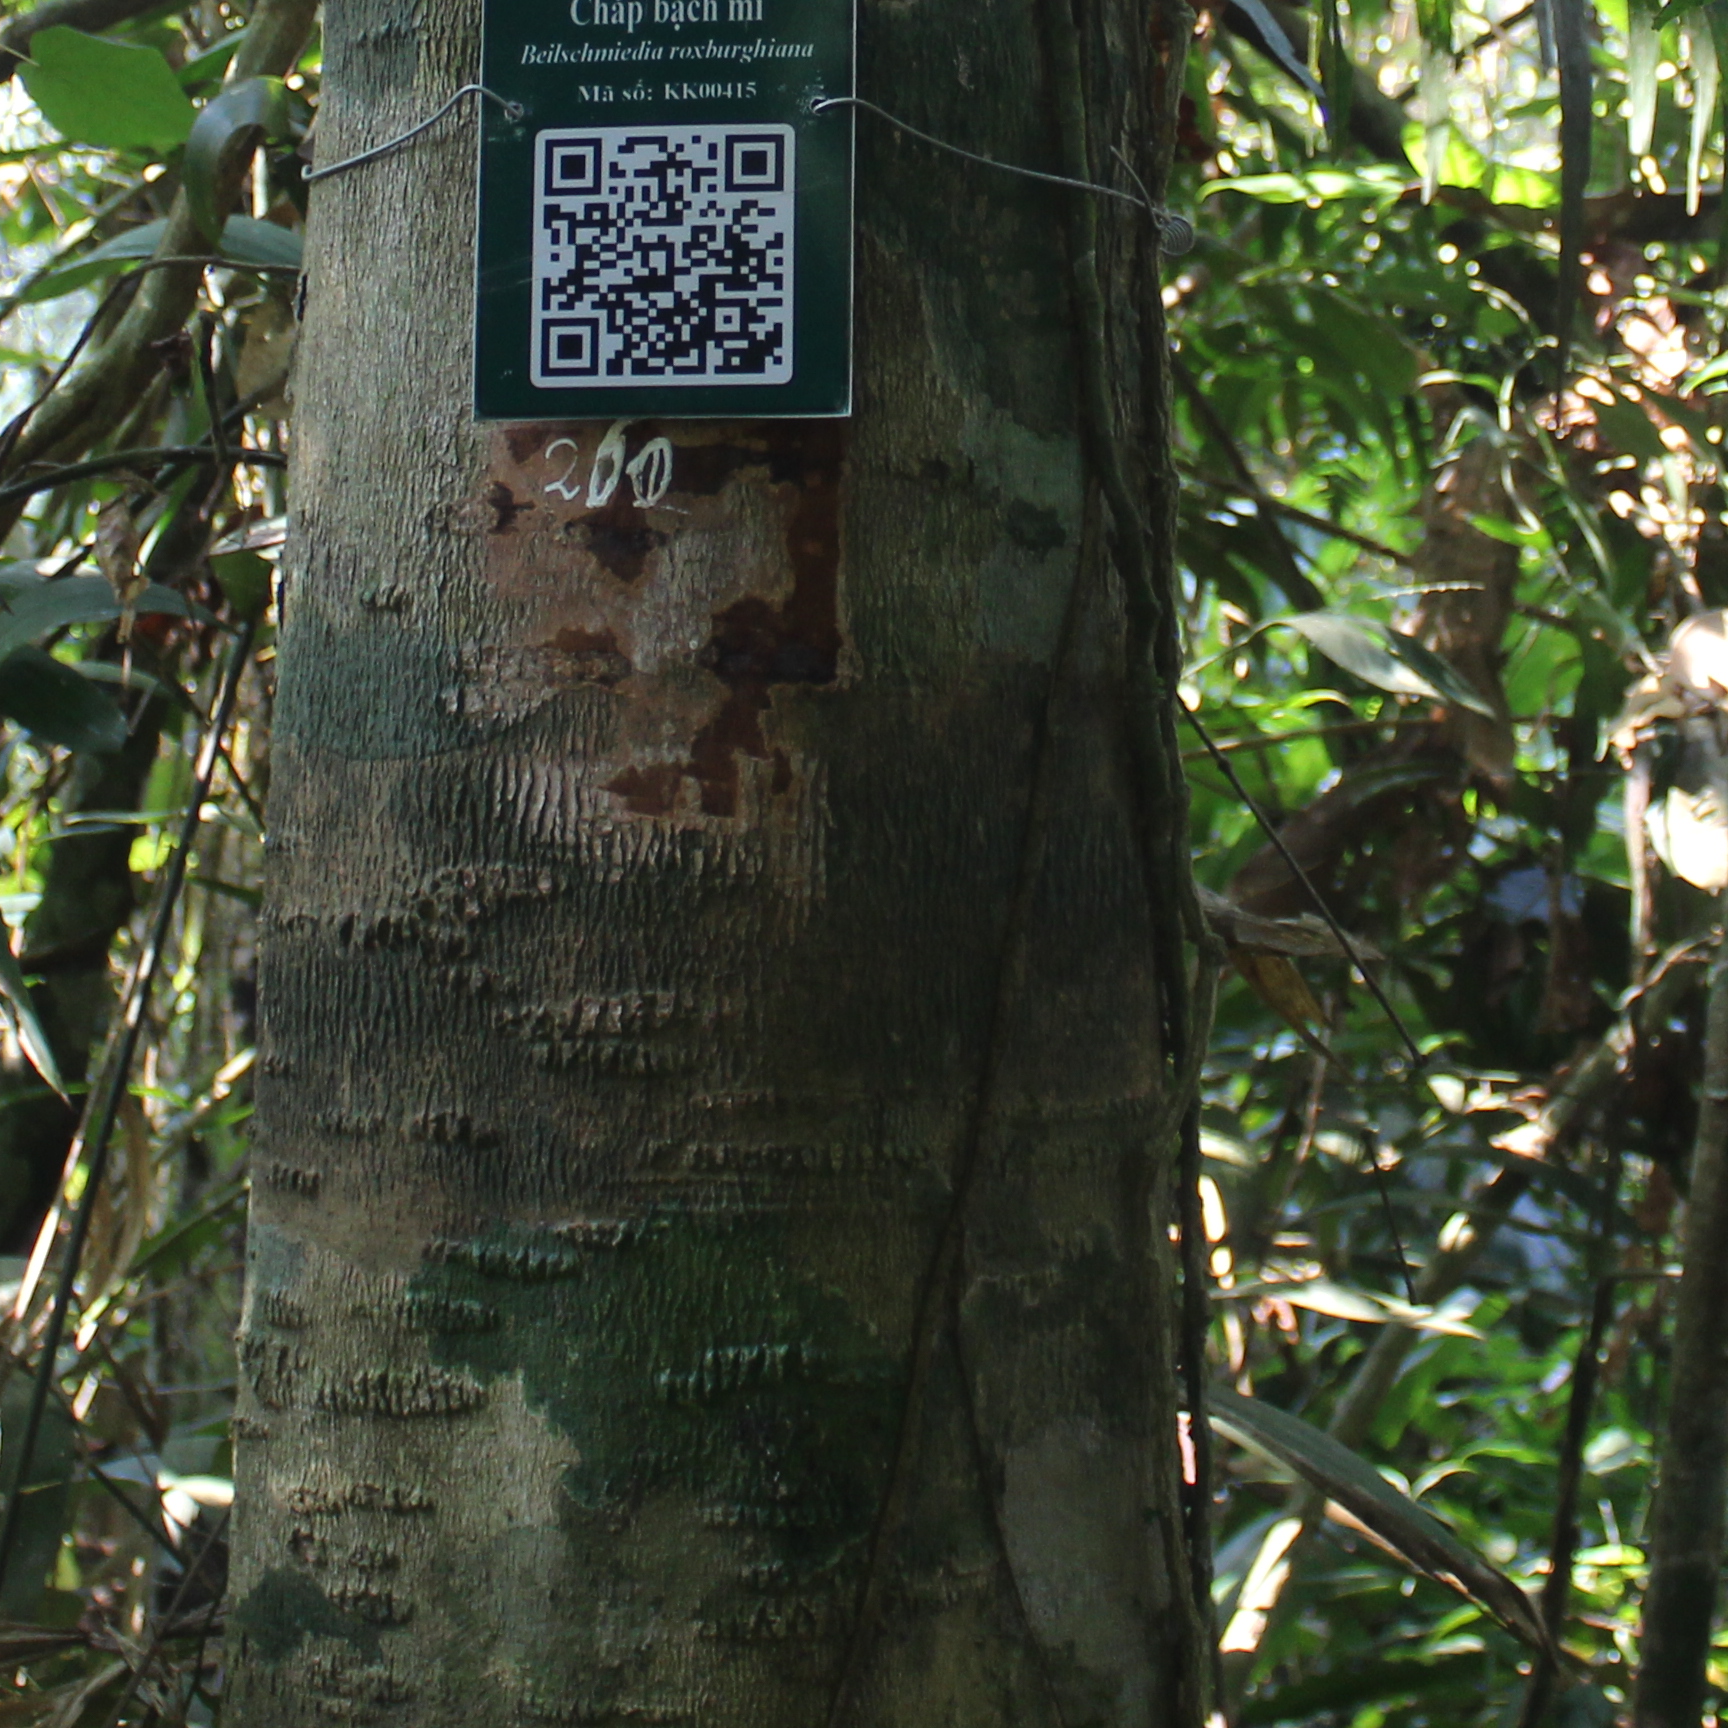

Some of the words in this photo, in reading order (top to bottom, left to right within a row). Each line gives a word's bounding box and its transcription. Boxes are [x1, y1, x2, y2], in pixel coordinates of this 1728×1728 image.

[521, 40, 663, 64] Beilschmiedia
[669, 38, 814, 64] roxburghiana
[578, 85, 614, 102] Mã
[622, 79, 653, 101] số:
[664, 82, 757, 101] KK00415
